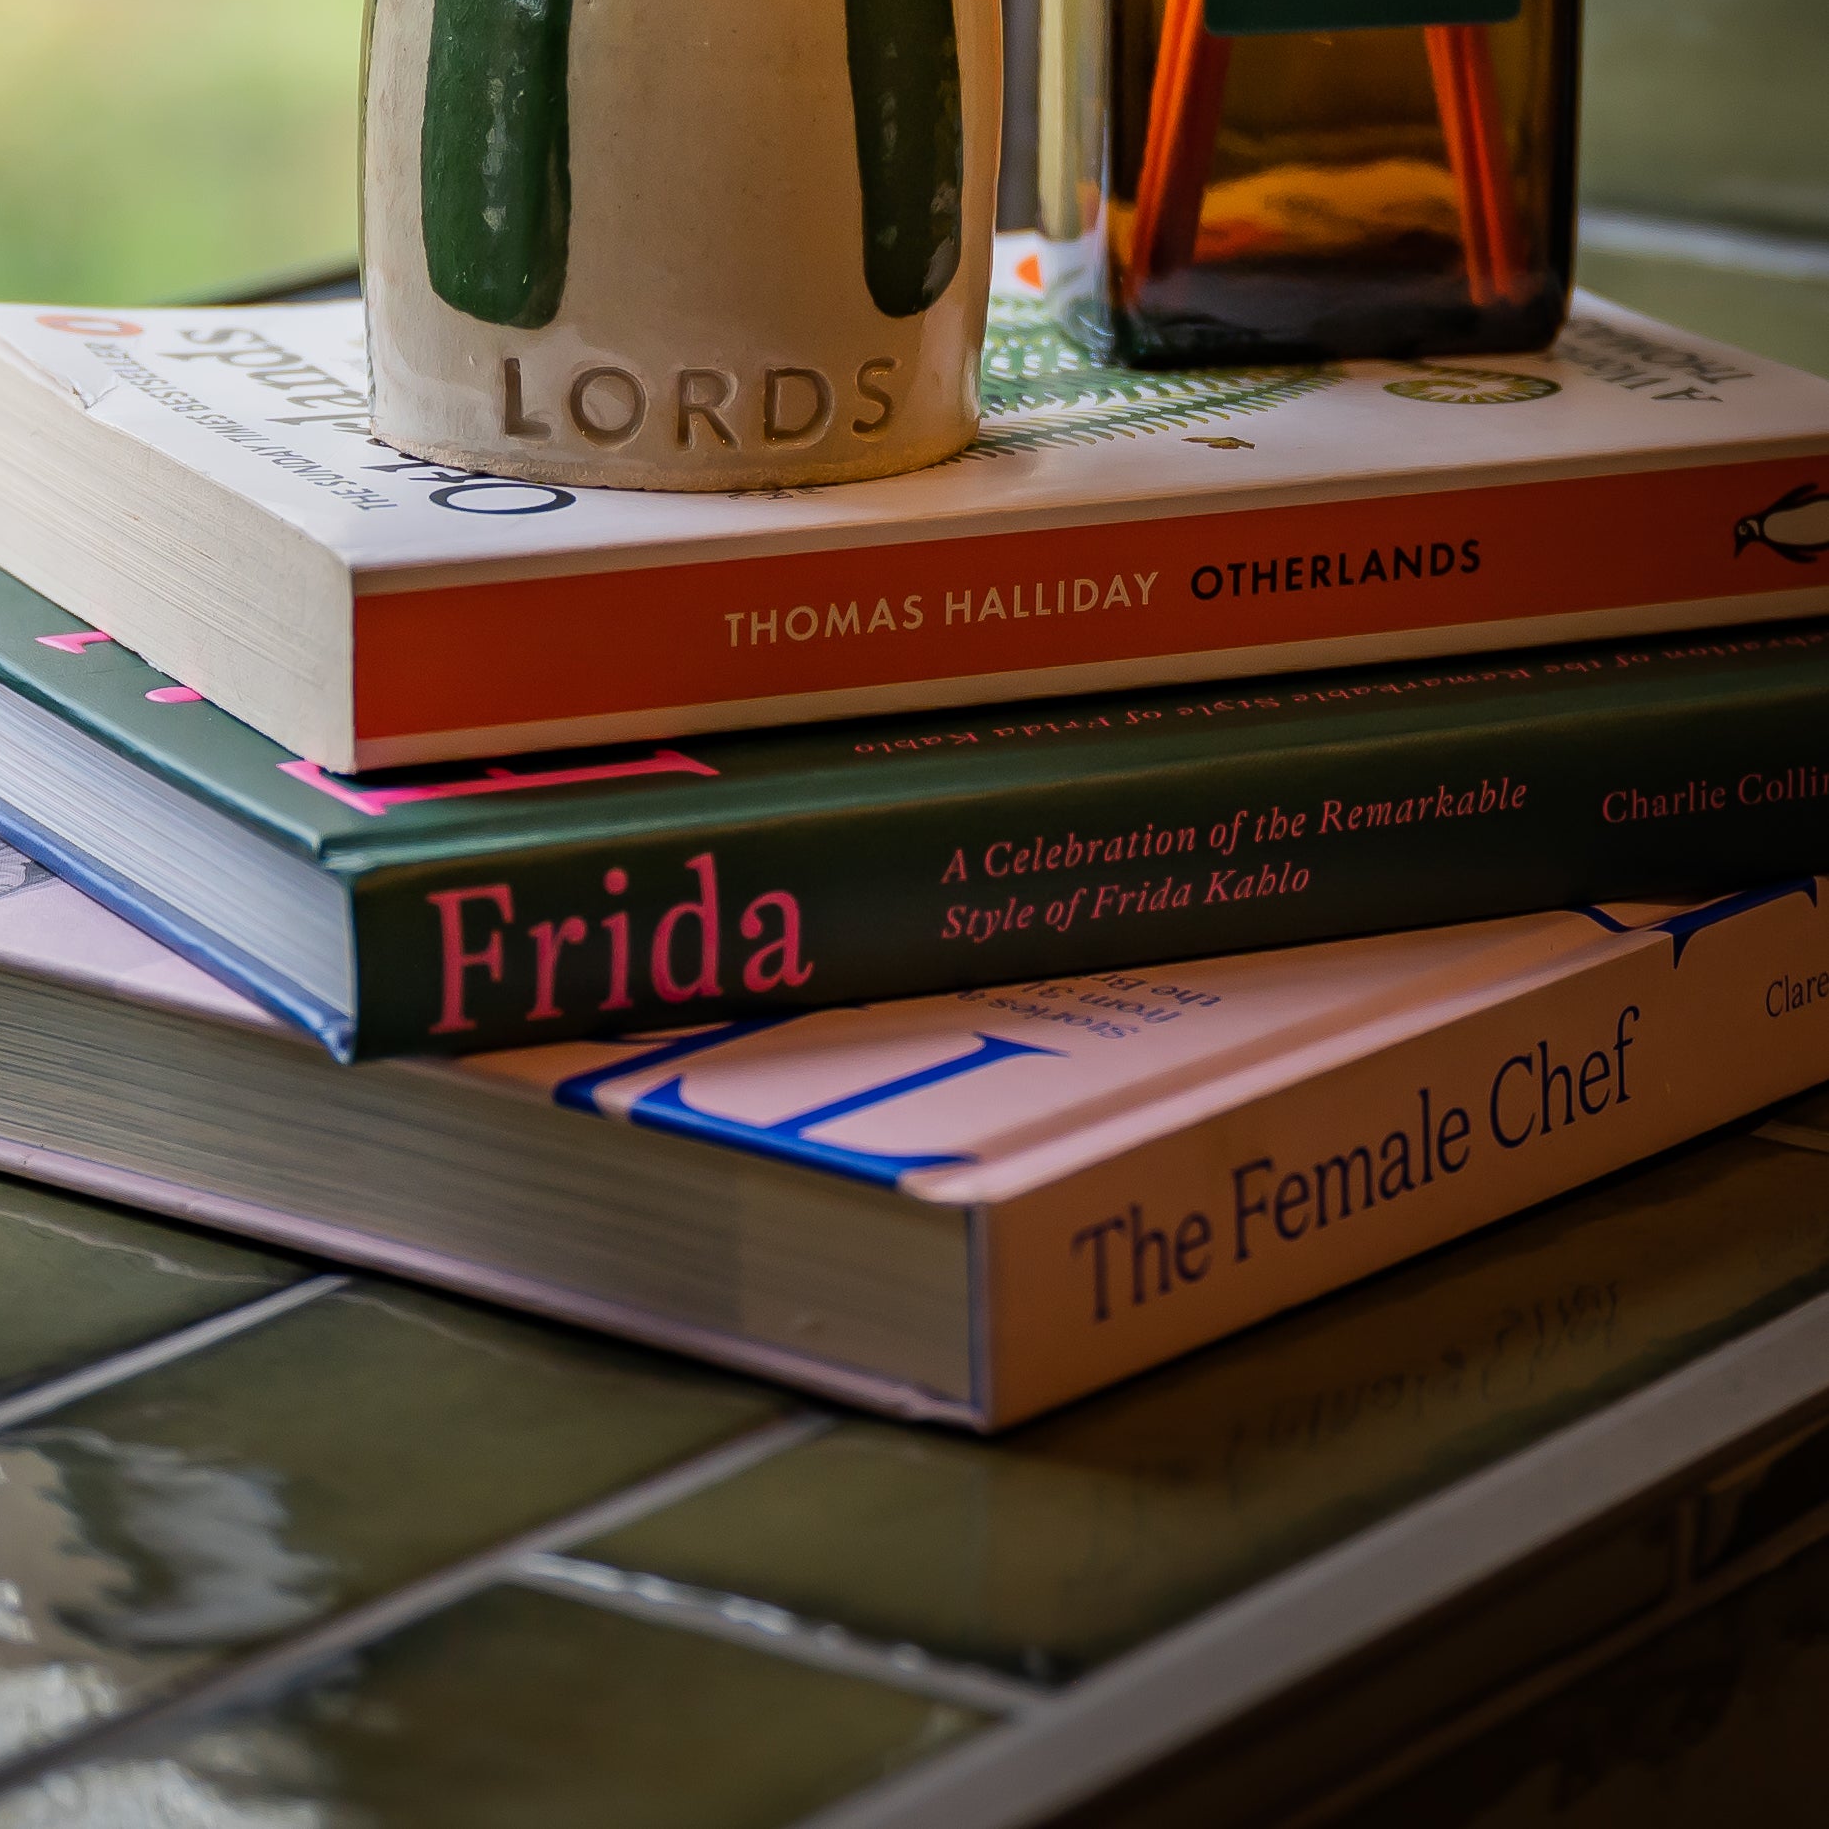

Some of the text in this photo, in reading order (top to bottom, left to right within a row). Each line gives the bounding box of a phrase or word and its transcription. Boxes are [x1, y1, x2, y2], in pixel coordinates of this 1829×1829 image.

[185, 413, 271, 443] TIMES
[502, 356, 899, 450] LORDS
[241, 444, 358, 487] SUNDAY
[330, 487, 399, 512] THE
[723, 537, 1483, 648] THOMAS HALLIDAY OTHERLANDS
[992, 716, 1111, 738] Frida
[940, 776, 1529, 885] A Celebration of the Remarkable
[1601, 779, 1728, 824] Charlie
[940, 860, 1311, 944] Style of Frida Kahlo
[425, 852, 814, 1035] Frida
[1765, 970, 1829, 1019] Clare
[1069, 1004, 1642, 1323] The Female Chef
